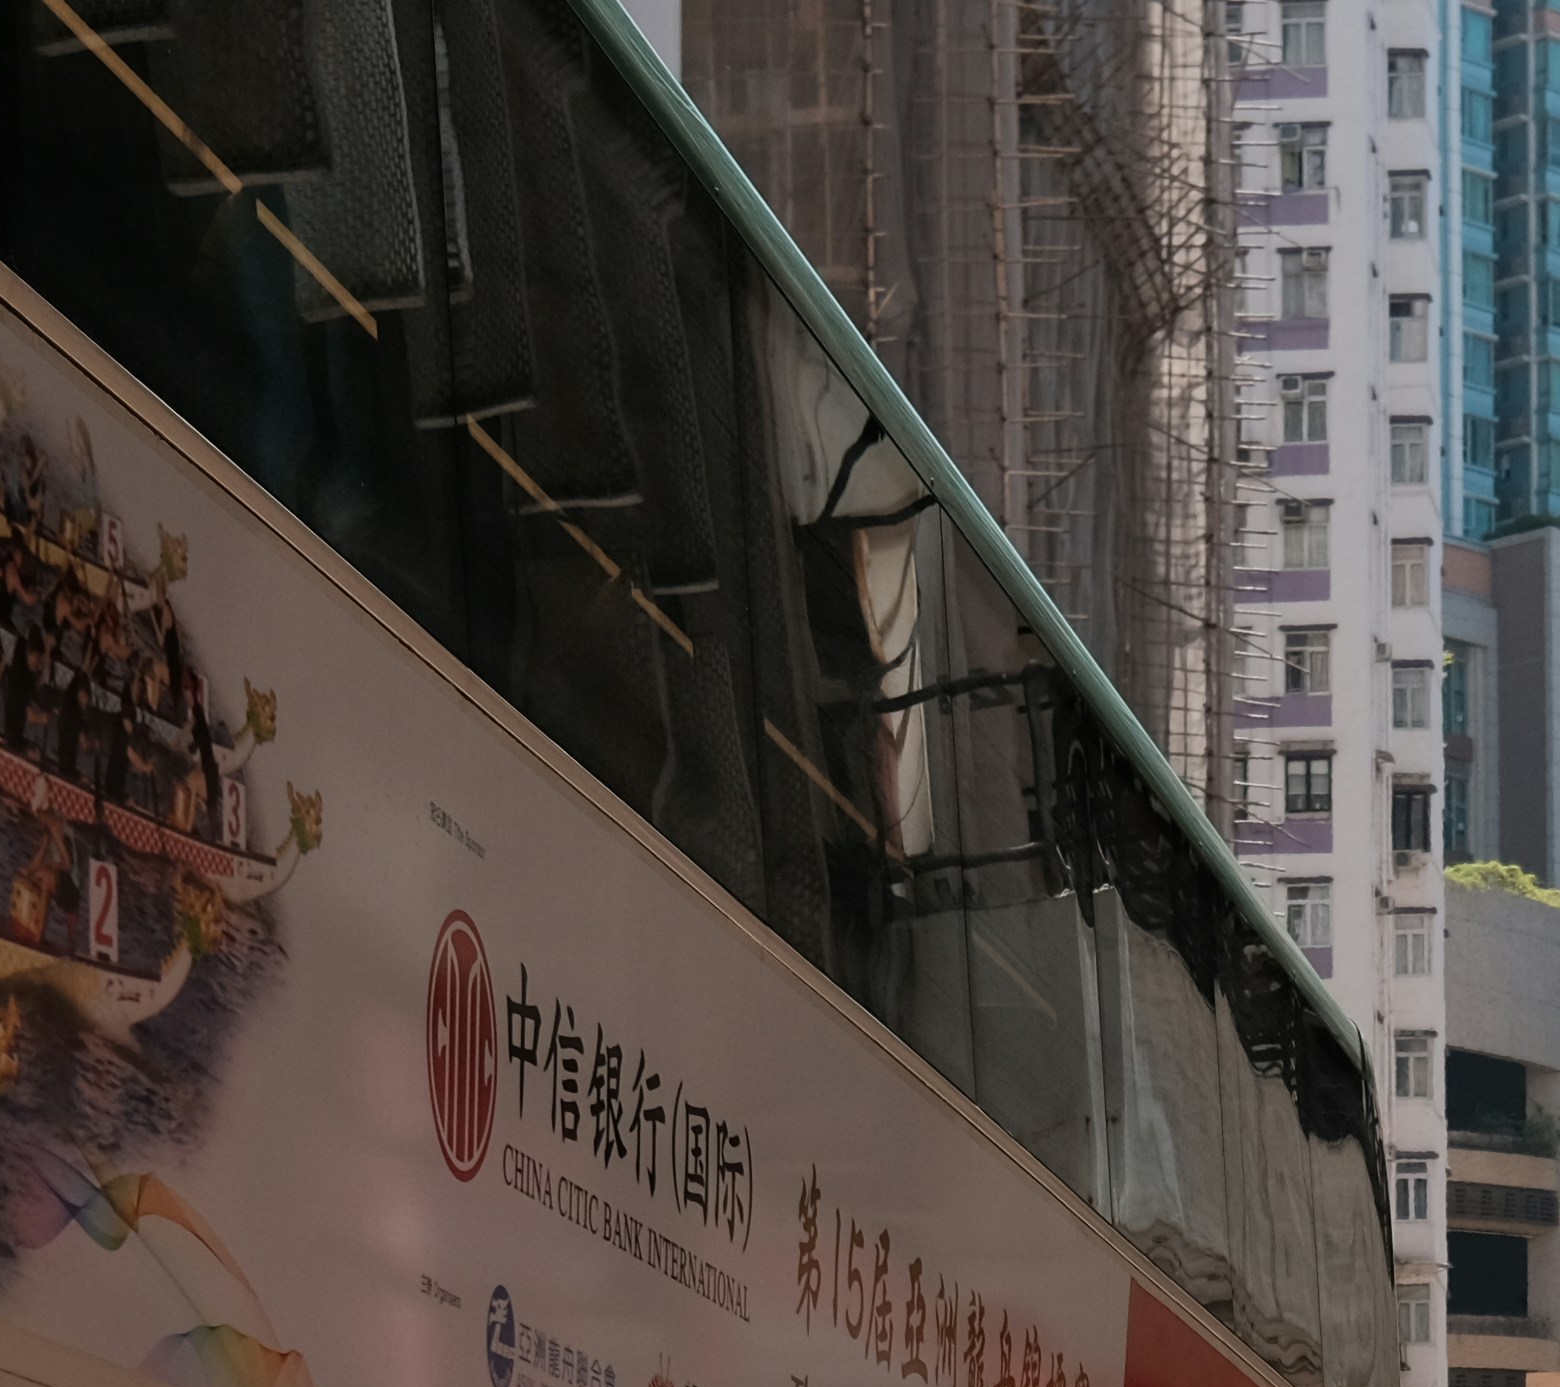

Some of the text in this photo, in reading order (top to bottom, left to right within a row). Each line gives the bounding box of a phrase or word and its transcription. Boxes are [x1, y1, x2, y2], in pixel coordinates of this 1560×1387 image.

[92, 868, 116, 951] 2
[506, 962, 754, 1253] 中信银行(国际)
[502, 1143, 751, 1323] CHINA CITIC BANK INTERNATIONAL
